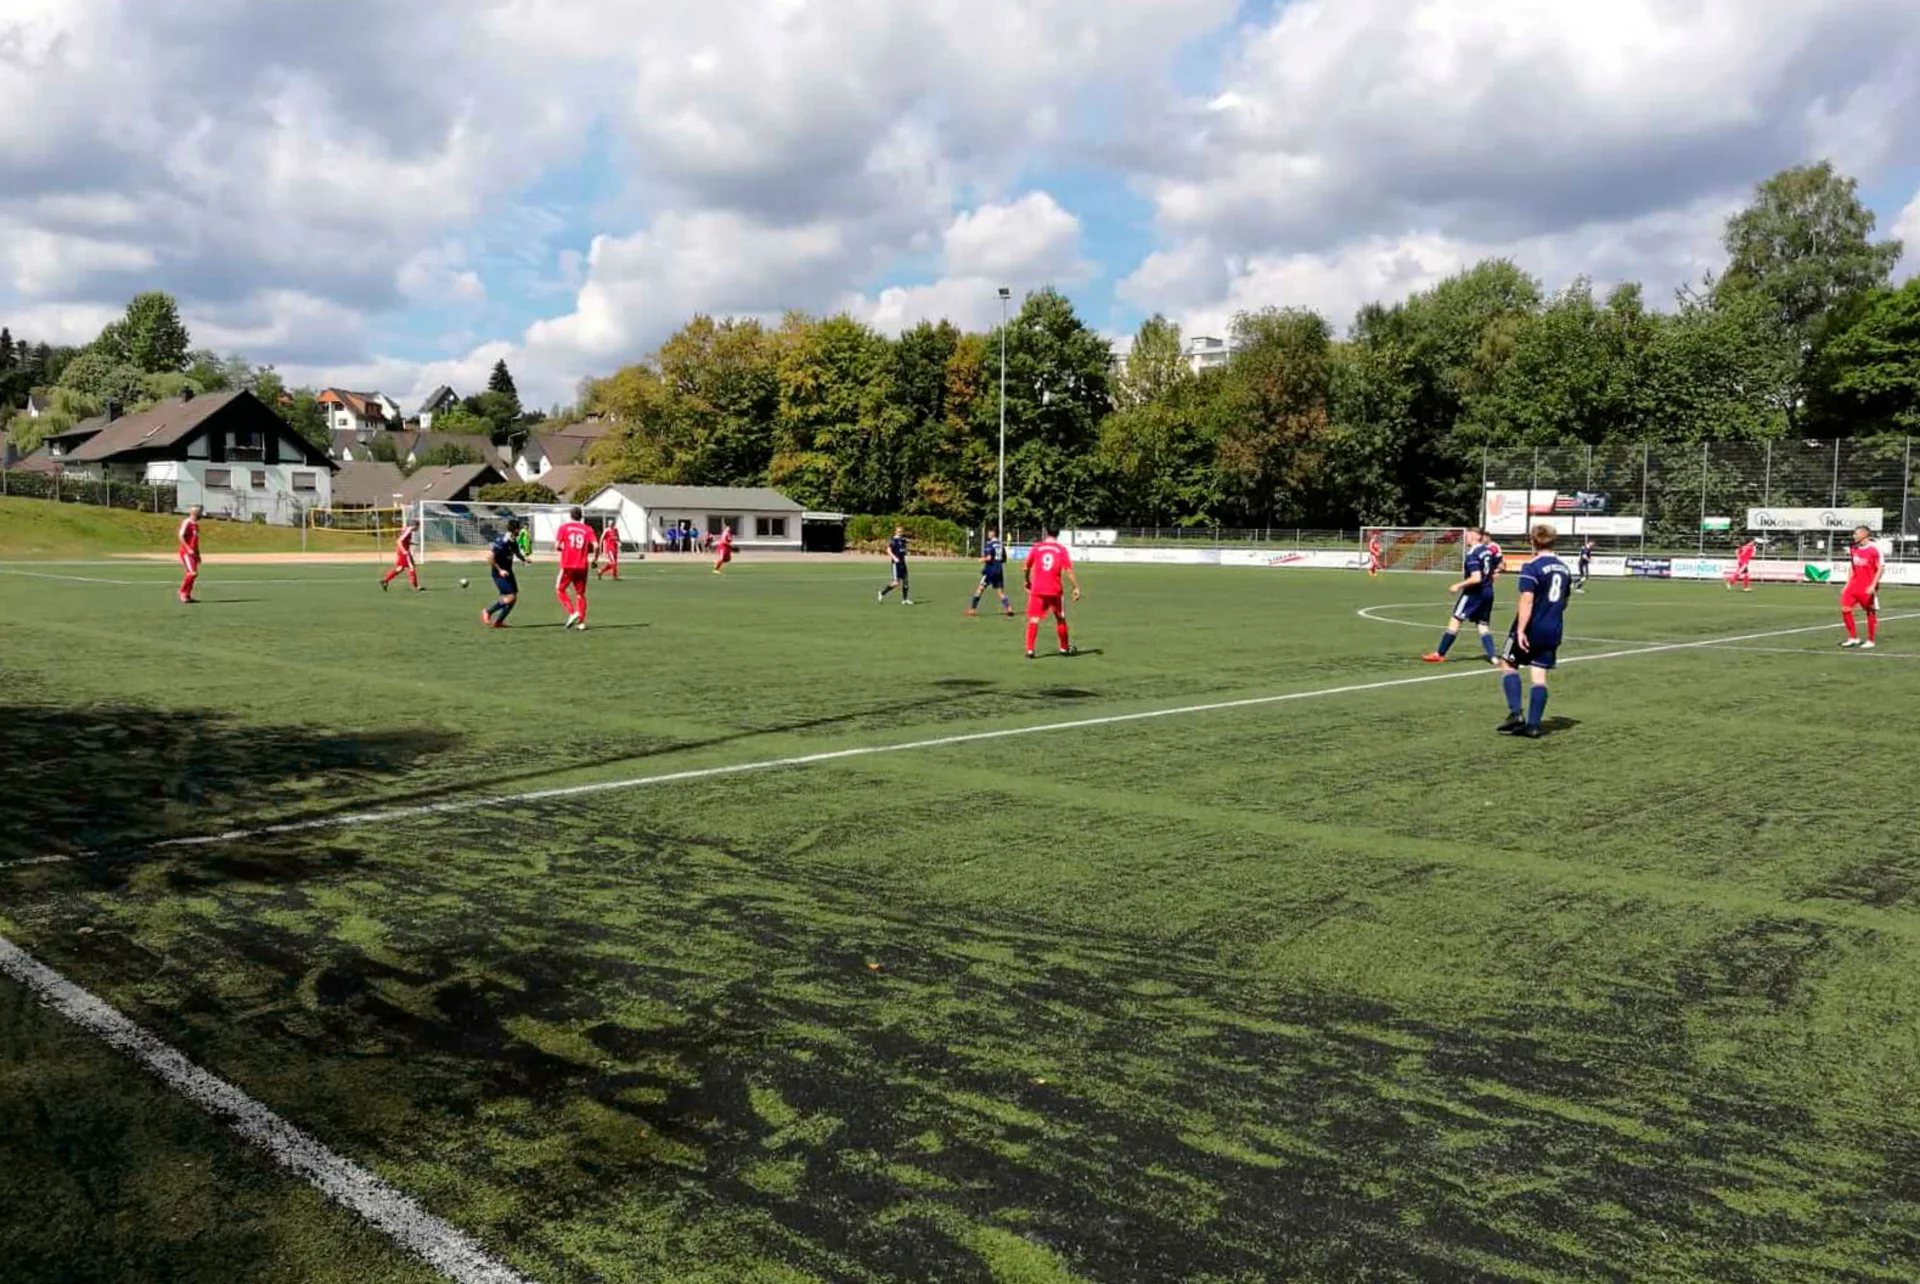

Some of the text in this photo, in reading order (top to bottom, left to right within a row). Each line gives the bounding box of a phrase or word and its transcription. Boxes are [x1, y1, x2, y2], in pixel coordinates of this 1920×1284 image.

[568, 533, 585, 549] 19
[1042, 553, 1055, 572] 9
[1548, 573, 1562, 603] 8
